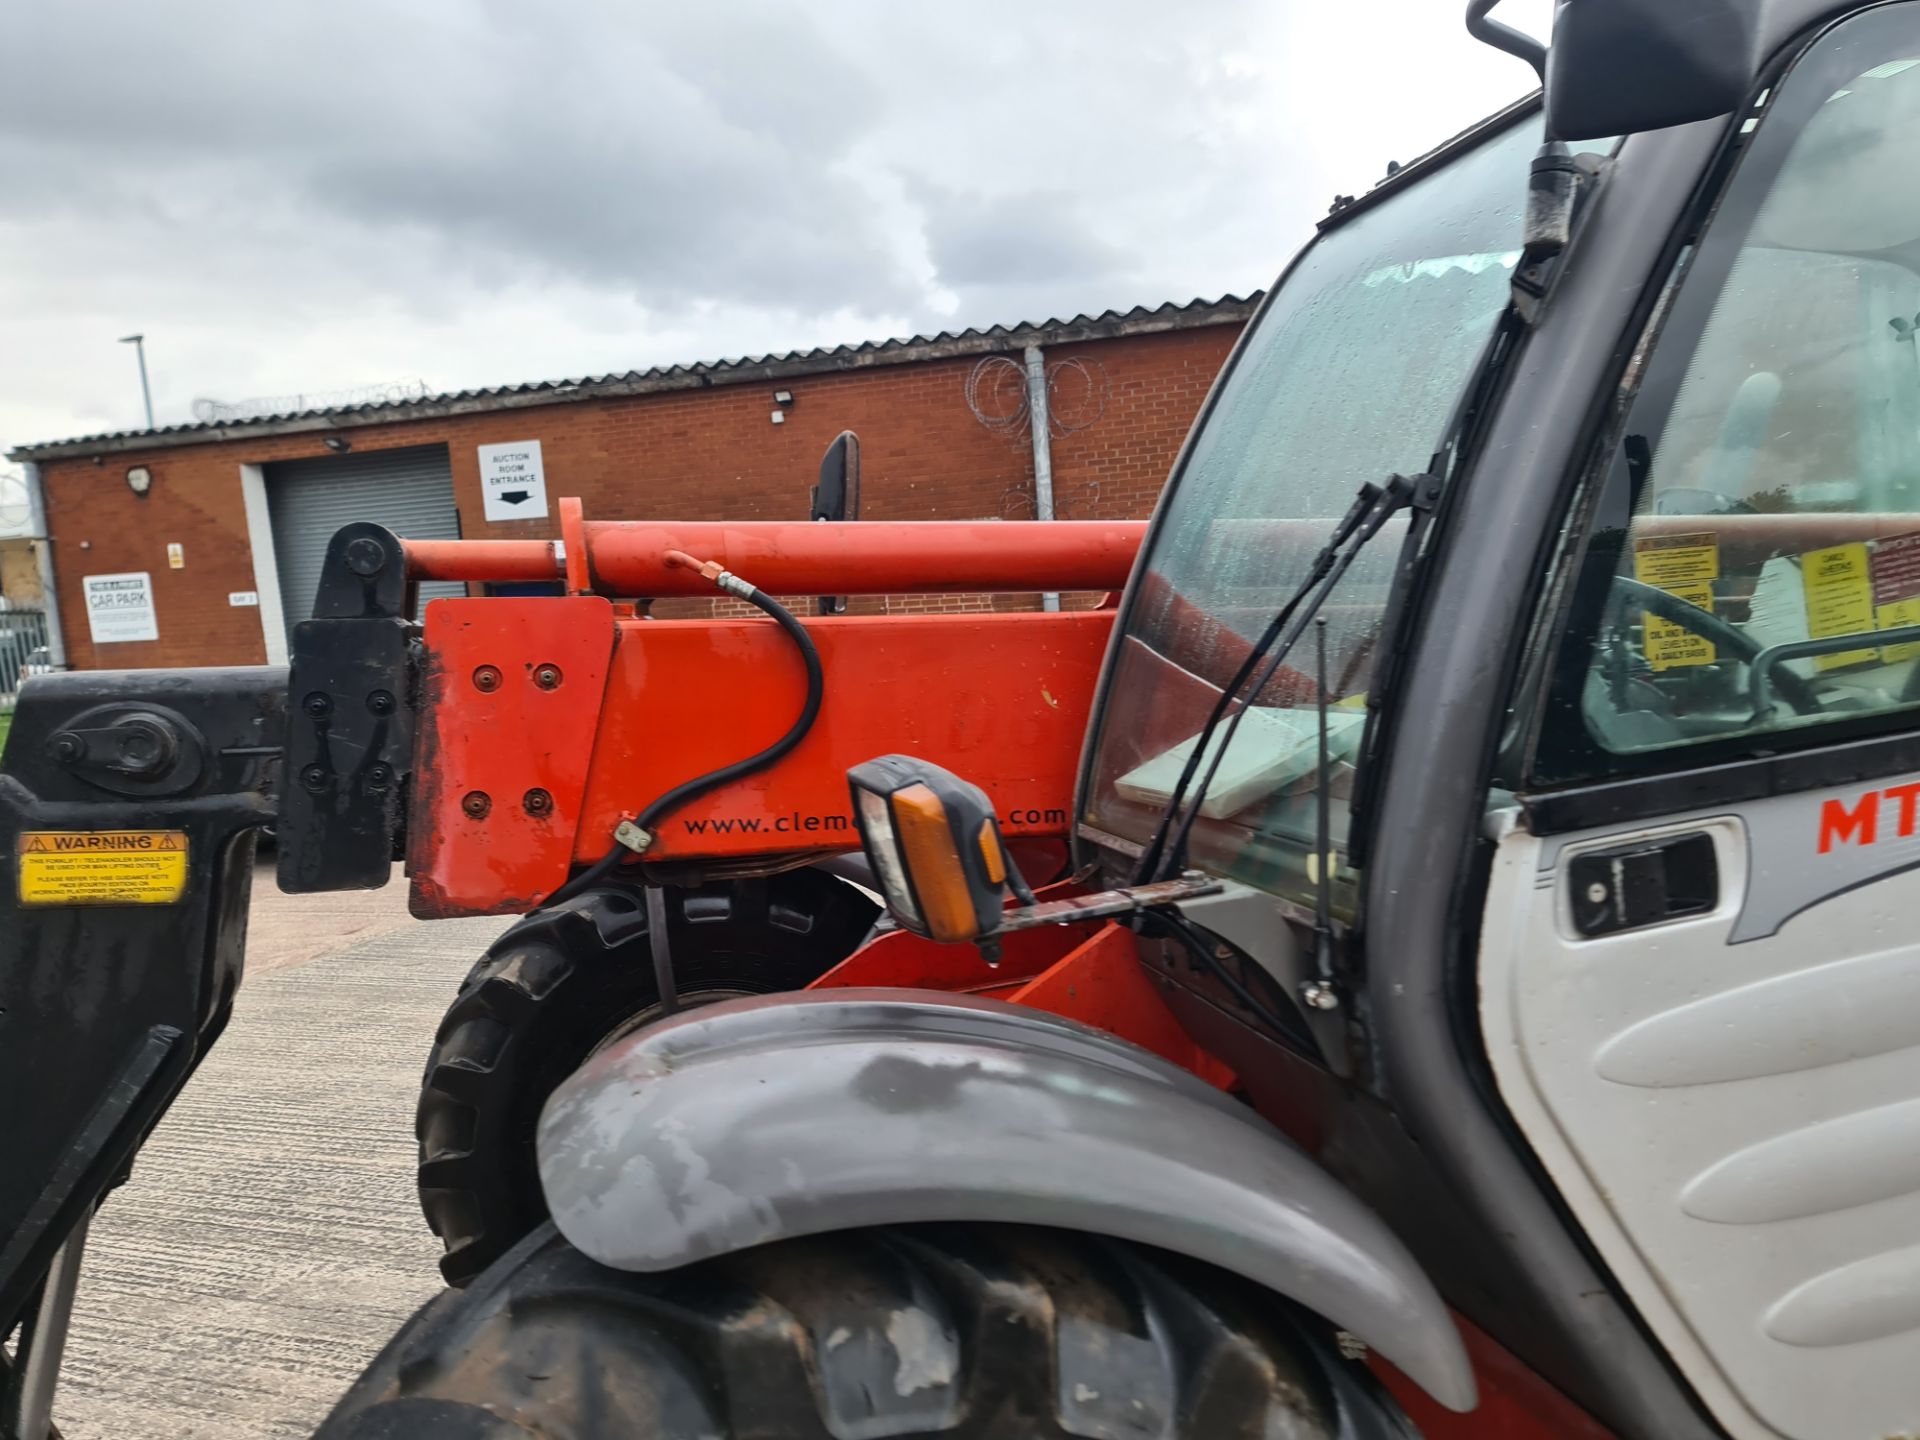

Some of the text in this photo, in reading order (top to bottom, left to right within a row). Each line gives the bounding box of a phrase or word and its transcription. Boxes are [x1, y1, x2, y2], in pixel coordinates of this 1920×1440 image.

[492, 453, 530, 463] AUCTION
[498, 464, 525, 473] ROOM
[490, 474, 536, 486] ENTRANCE
[90, 592, 148, 609] CAR PARK
[53, 834, 152, 851] WARNING
